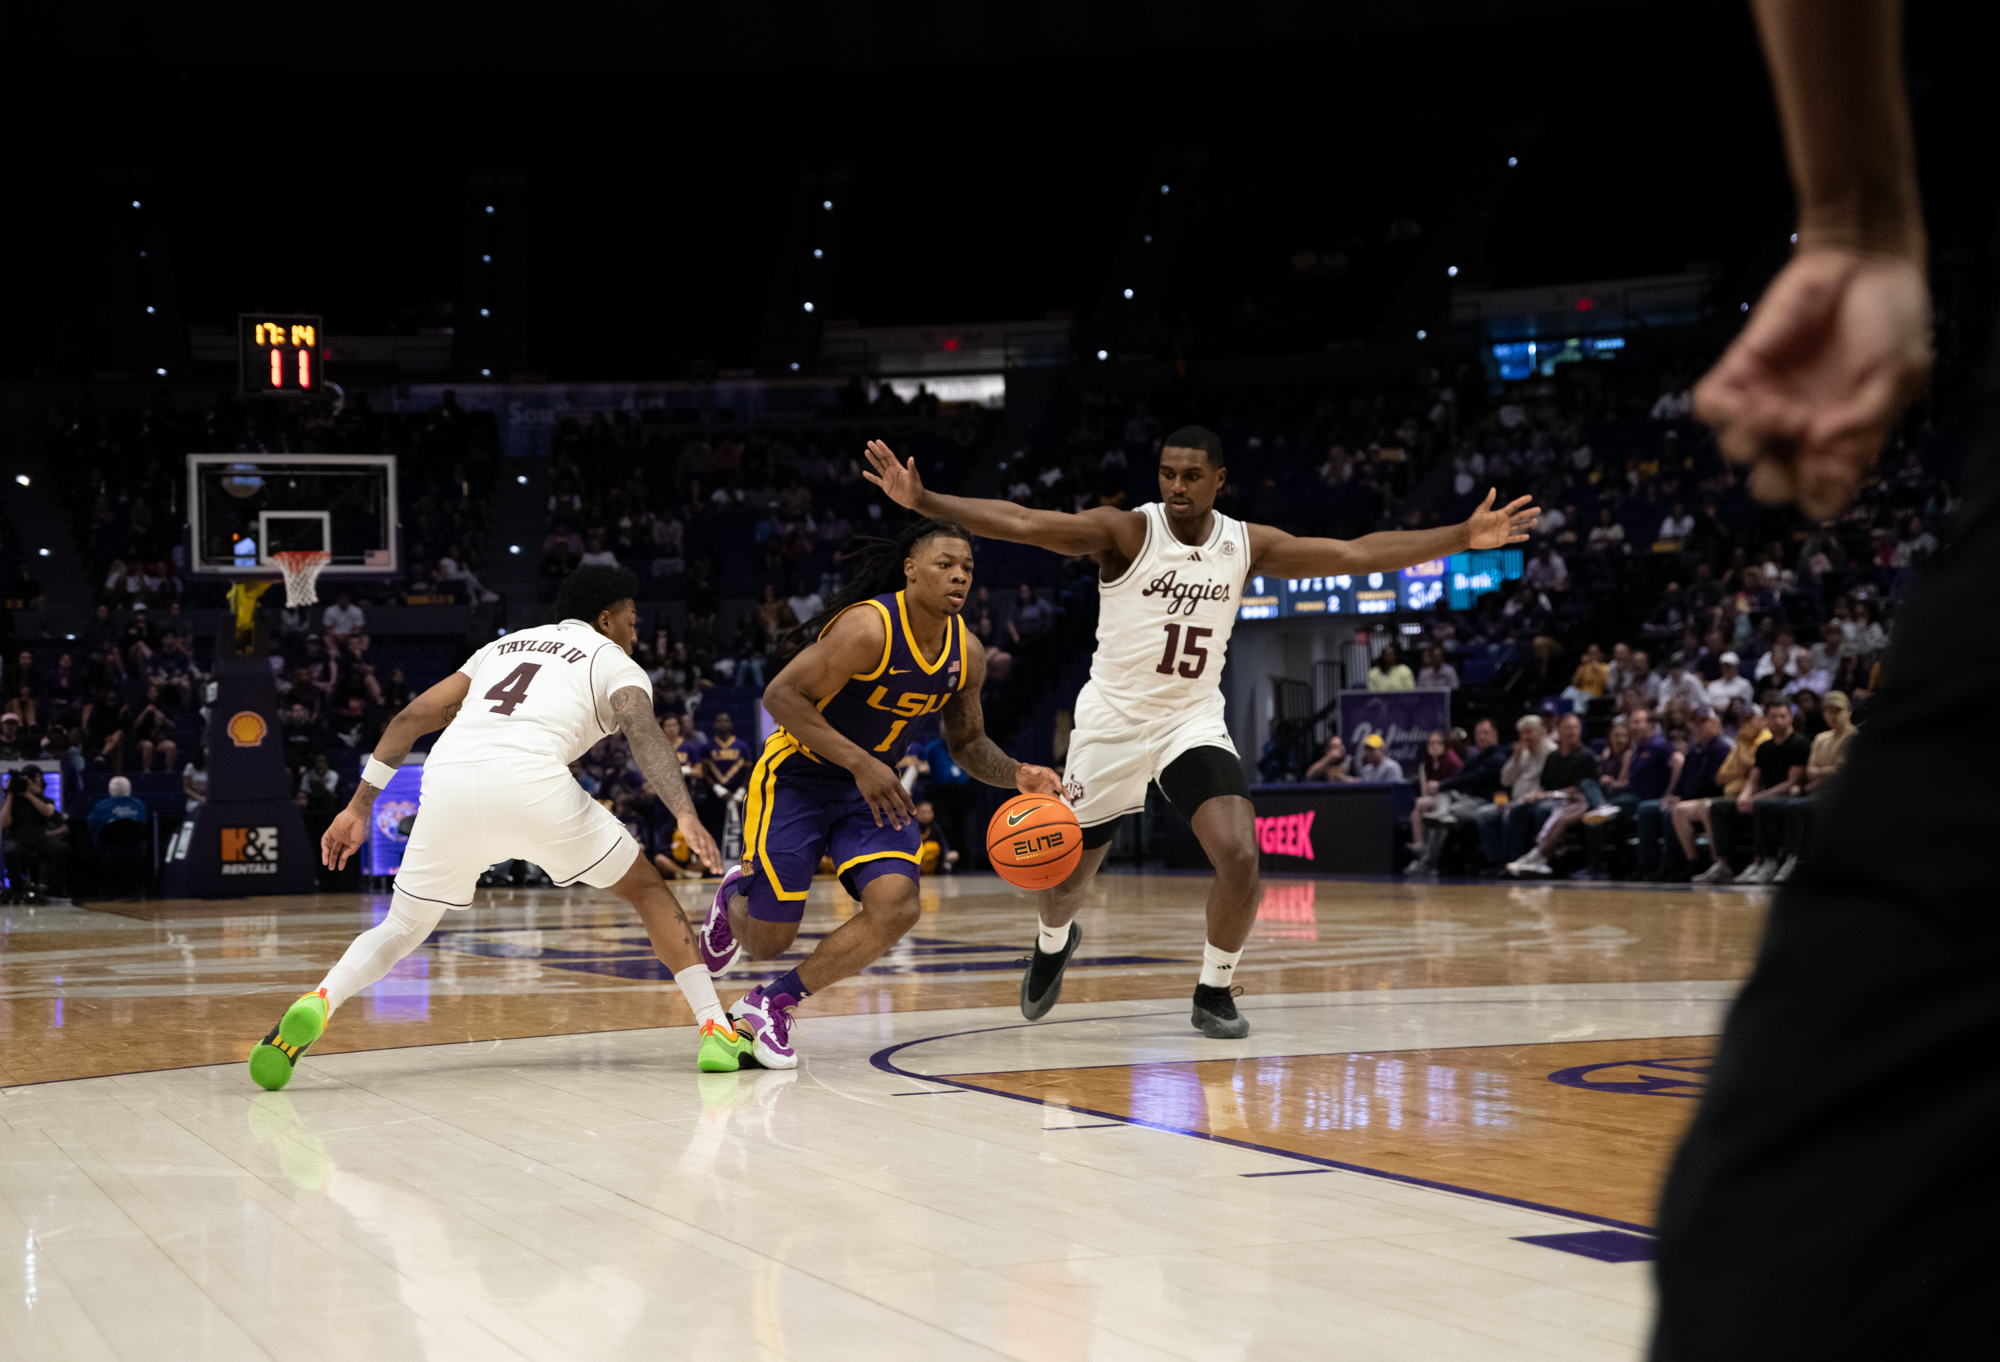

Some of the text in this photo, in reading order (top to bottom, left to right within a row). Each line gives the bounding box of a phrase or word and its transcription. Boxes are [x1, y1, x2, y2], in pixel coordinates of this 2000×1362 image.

[270, 348, 311, 389] 11
[1142, 570, 1230, 616] Aggies
[497, 640, 587, 664] TAYLOR IV
[1156, 623, 1213, 679] 15
[483, 662, 542, 716] 4
[866, 685, 952, 717] LSU
[873, 720, 908, 752] 1
[221, 826, 278, 861] H&E
[1013, 832, 1065, 856] ELITE
[221, 862, 278, 875] RENTALS
